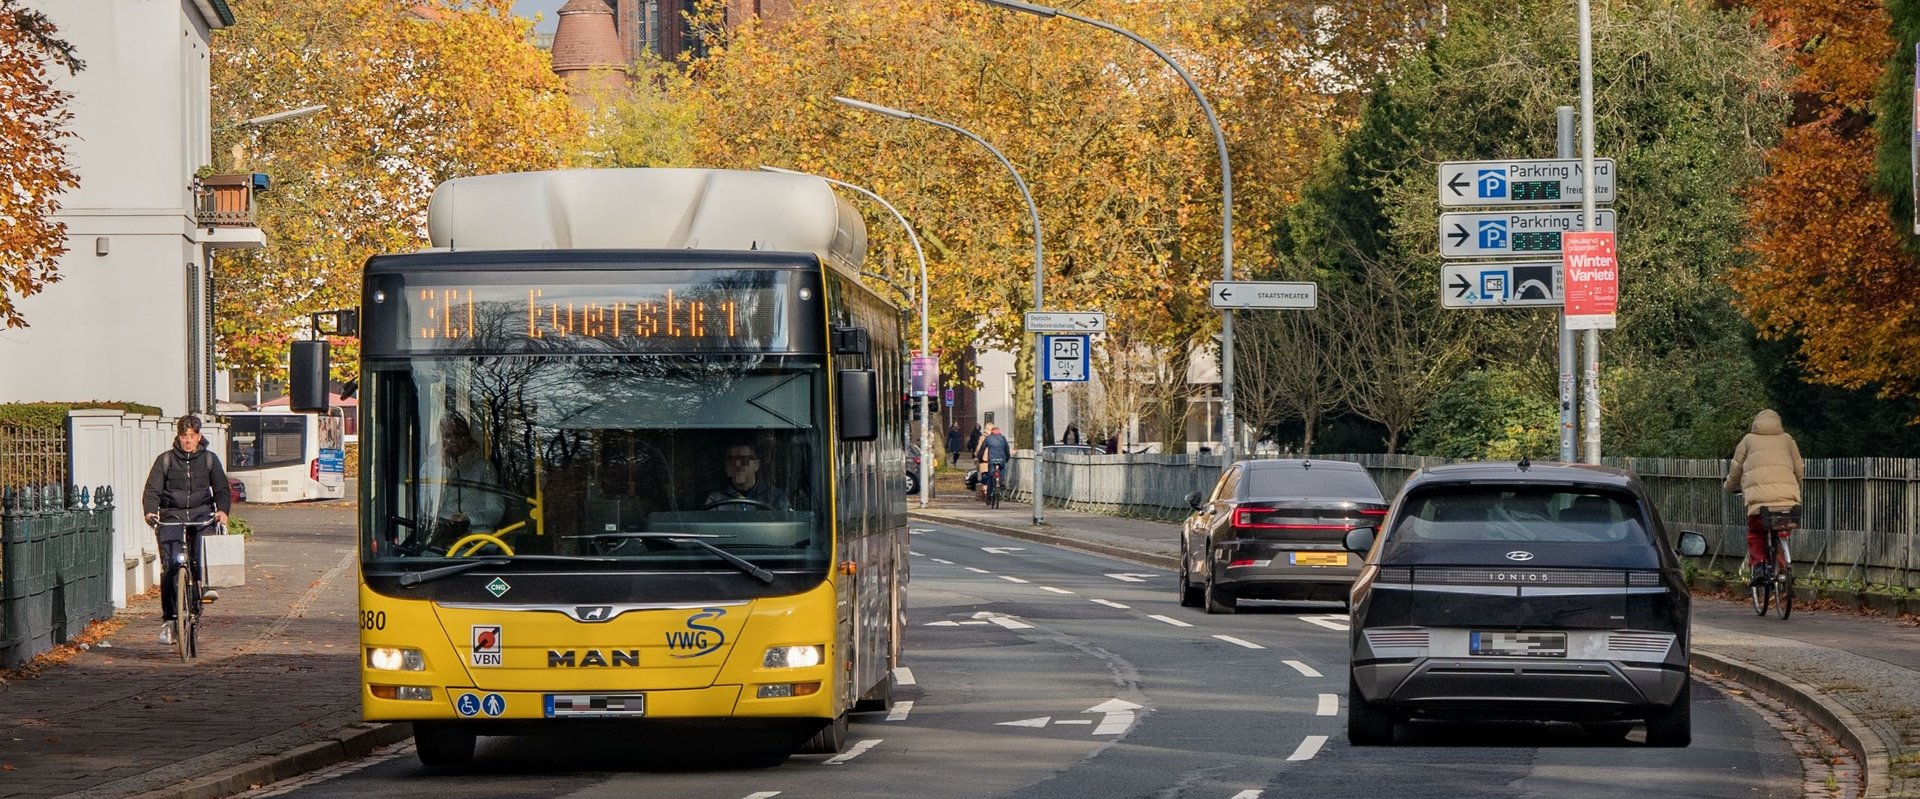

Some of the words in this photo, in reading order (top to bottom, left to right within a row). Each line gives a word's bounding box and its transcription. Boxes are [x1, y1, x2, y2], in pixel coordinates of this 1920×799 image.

[1510, 164, 1568, 179] Parkring
[1575, 163, 1608, 176] Nrd
[1512, 182, 1559, 199] 976
[1511, 215, 1569, 230] Parkring
[1576, 214, 1602, 226] Sd
[1569, 255, 1612, 268] Winter
[1570, 268, 1614, 282] Varieté
[1054, 343, 1079, 356] P+R
[1058, 361, 1074, 370] City
[490, 583, 506, 591] CNG
[360, 610, 386, 631] 380
[666, 631, 709, 650] VWG
[473, 654, 501, 665] VBN
[547, 649, 640, 668] MAN
